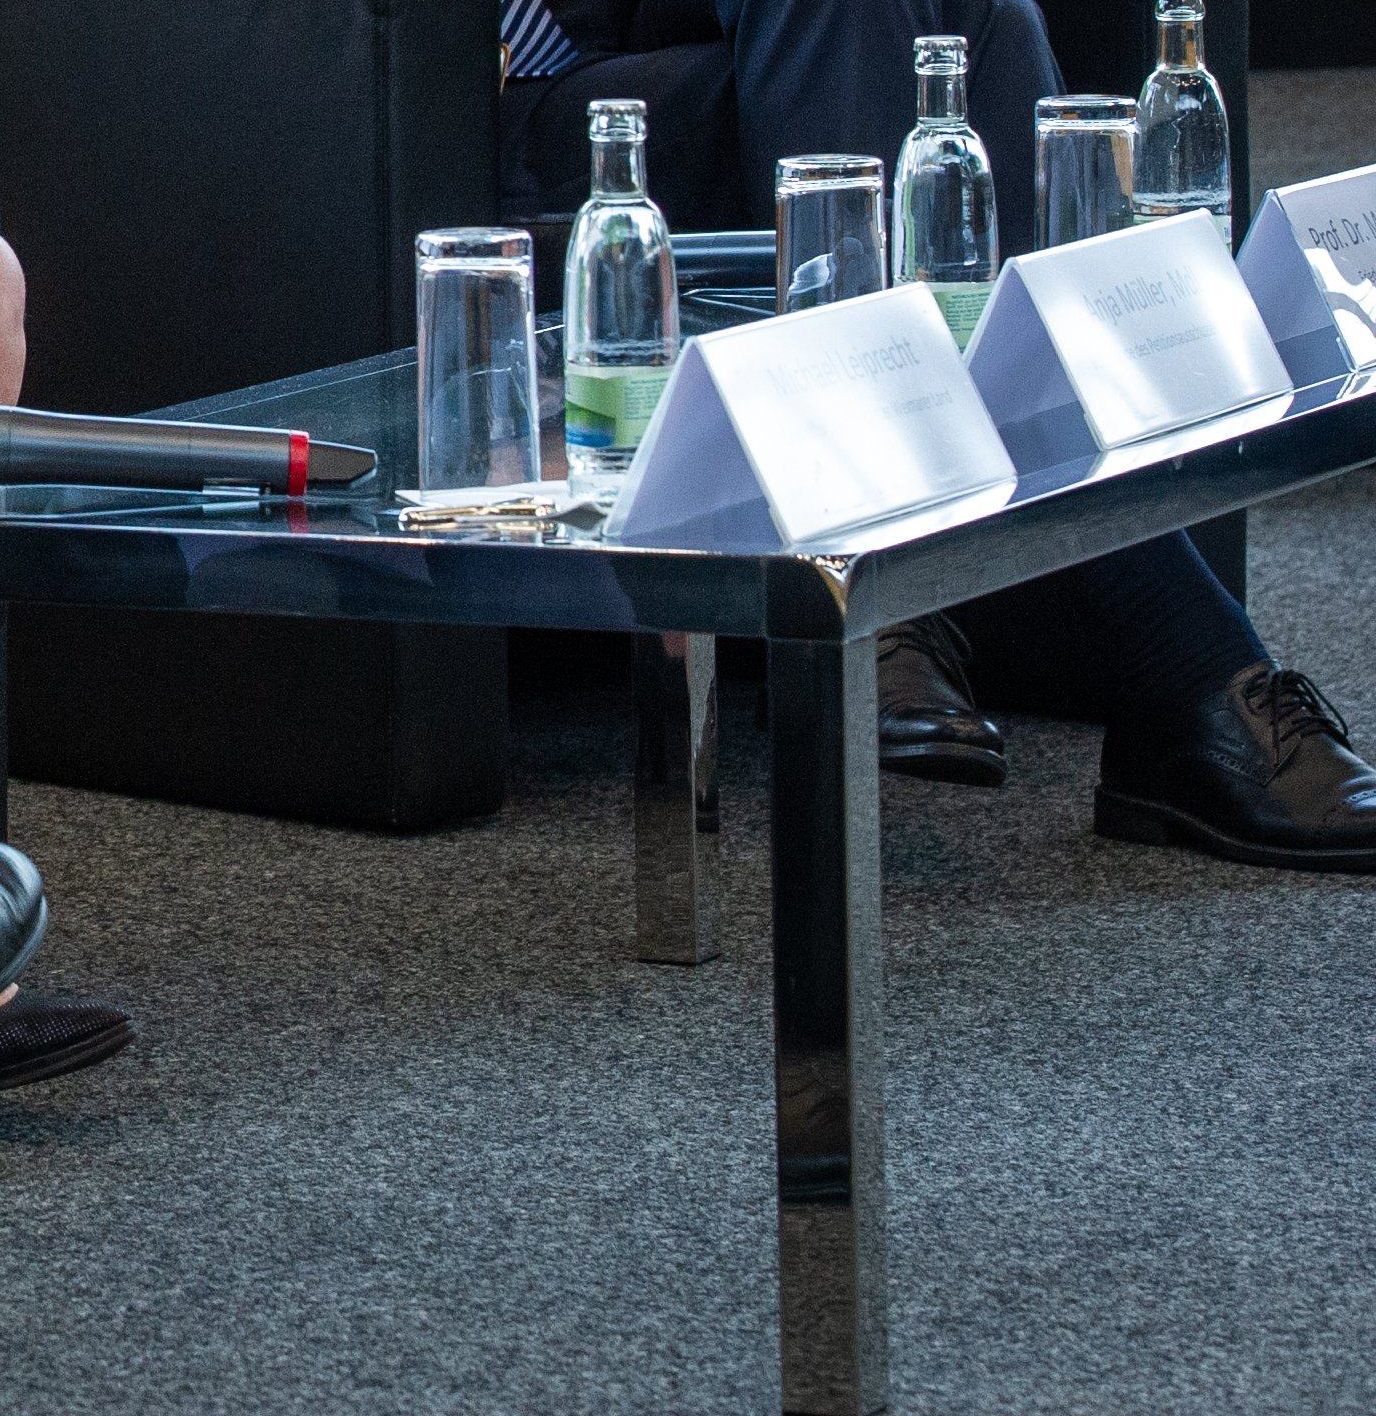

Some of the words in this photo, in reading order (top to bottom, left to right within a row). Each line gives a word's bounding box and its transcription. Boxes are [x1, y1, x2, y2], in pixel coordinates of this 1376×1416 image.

[1308, 219, 1348, 252] Prof.
[1342, 218, 1370, 245] Dr.
[1083, 289, 1123, 326] Anja
[1115, 276, 1176, 314] Müller,
[766, 350, 842, 398] Michael
[835, 336, 920, 382] Leiprecht
